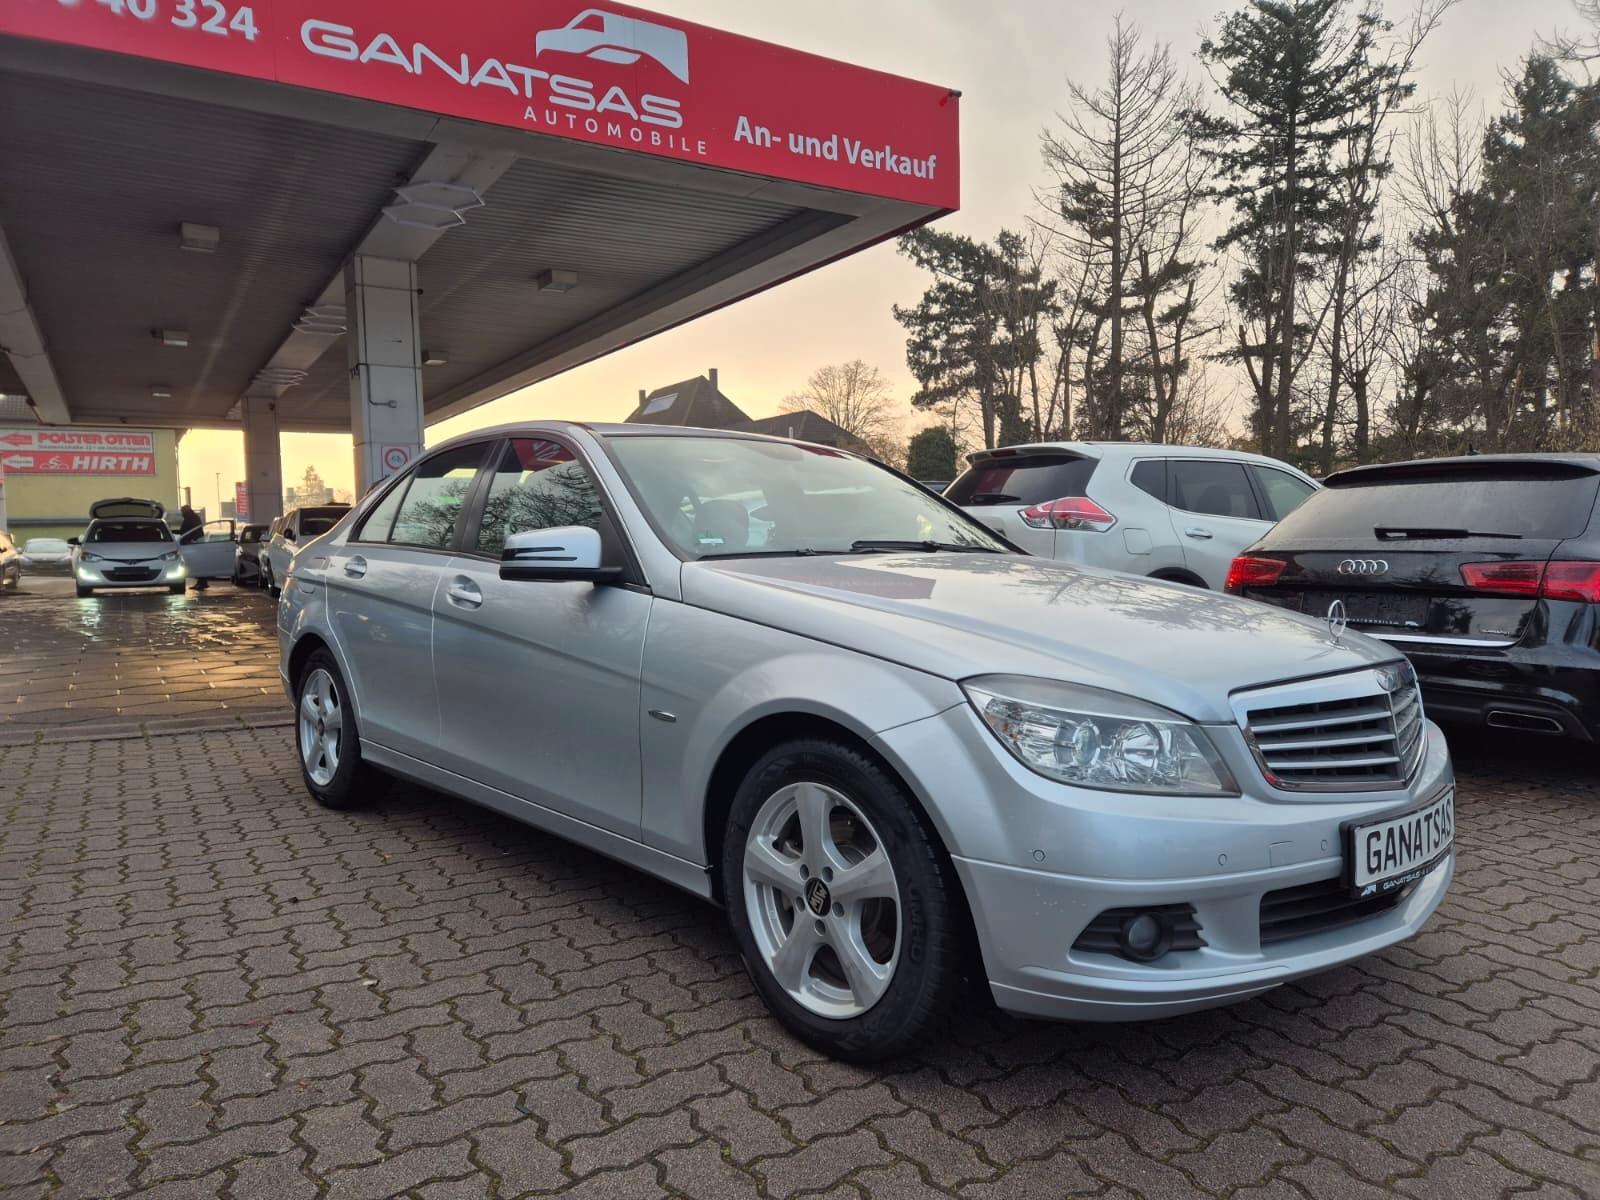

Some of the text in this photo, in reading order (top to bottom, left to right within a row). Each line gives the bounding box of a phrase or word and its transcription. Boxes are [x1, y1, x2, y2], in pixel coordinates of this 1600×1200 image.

[171, 0, 260, 41] 324
[301, 19, 683, 129] GANATSAS
[523, 105, 708, 156] AUTOMOBILE
[734, 115, 937, 180] An- und Verkauf
[37, 432, 103, 445] POLSTER
[104, 433, 151, 446] OTTER
[72, 455, 150, 471] HIRTH
[1366, 797, 1451, 875] GANATSAS
